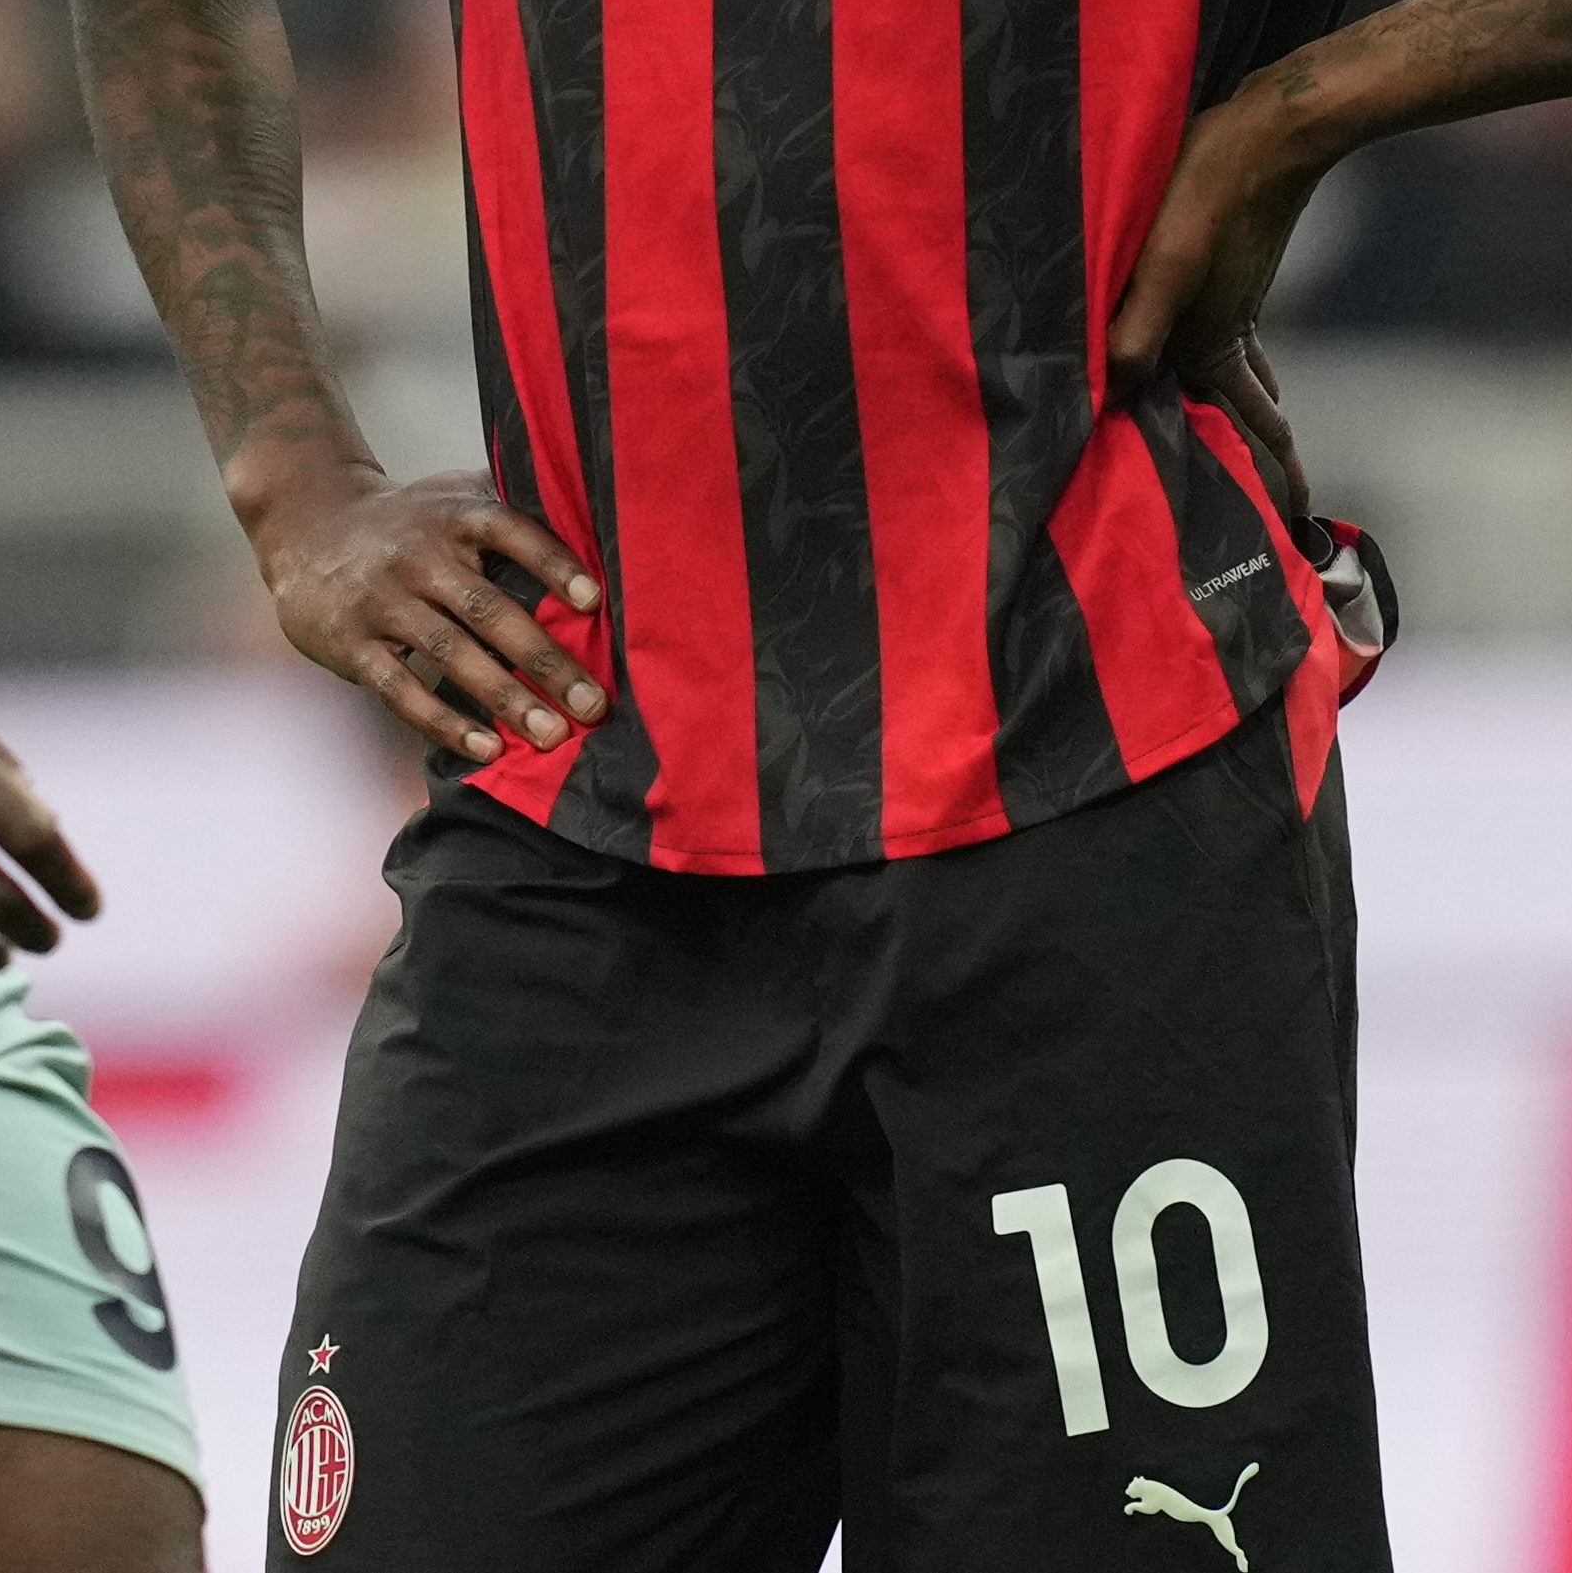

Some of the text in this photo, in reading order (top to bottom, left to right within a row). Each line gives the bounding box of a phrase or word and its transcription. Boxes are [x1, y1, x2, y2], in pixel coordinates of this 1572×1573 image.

[1190, 553, 1271, 601] ULTRAWEAVE
[66, 1146, 177, 1371] 9
[991, 1158, 1269, 1437] 10
[298, 1400, 338, 1434] ACM
[296, 1515, 331, 1536] 1899
